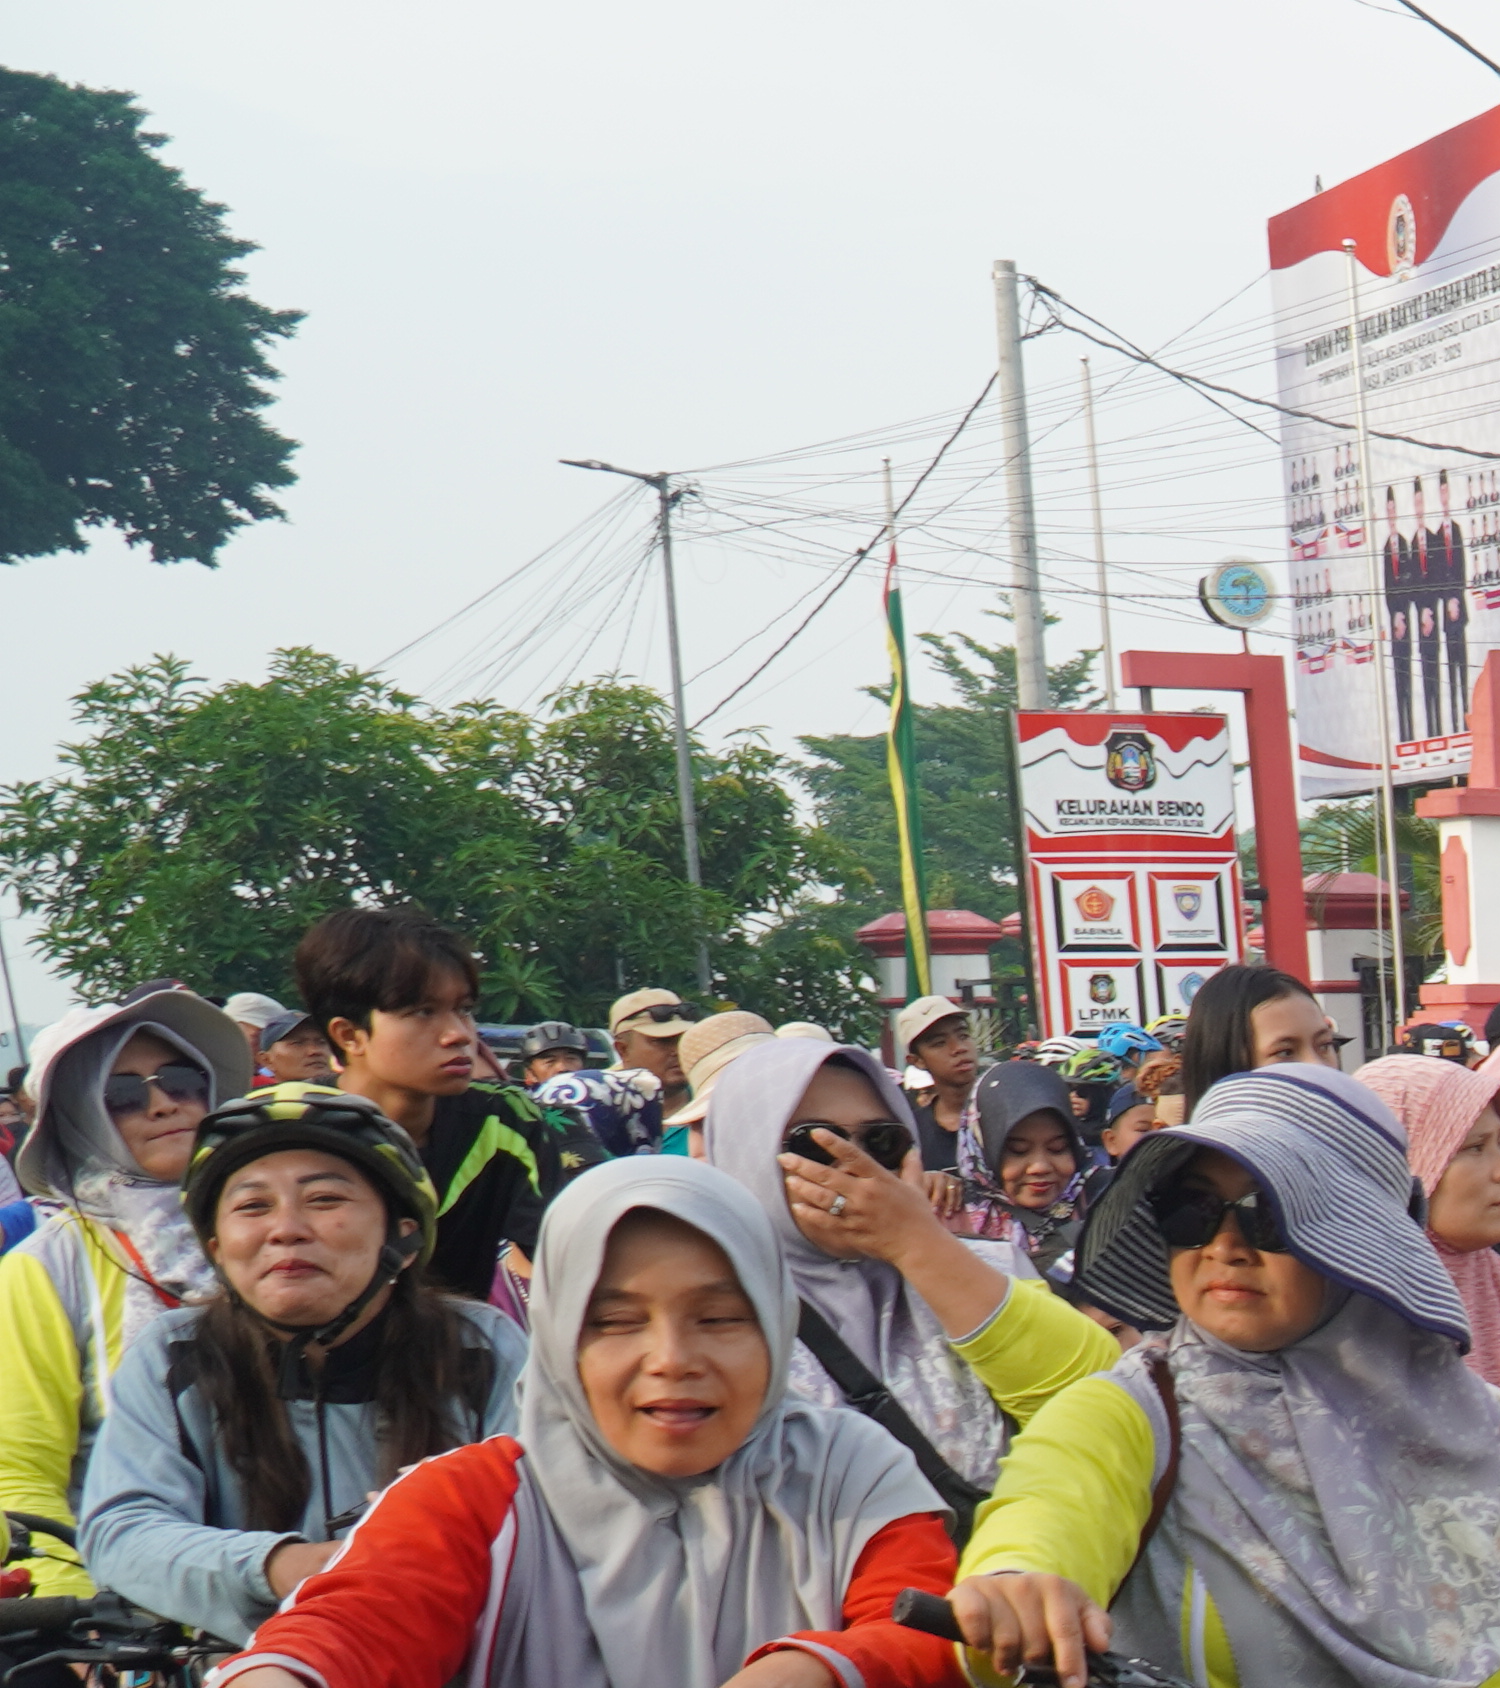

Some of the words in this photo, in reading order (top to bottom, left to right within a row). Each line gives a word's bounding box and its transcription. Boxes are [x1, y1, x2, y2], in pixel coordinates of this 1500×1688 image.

[1055, 799, 1153, 816] KELURAHAN
[1157, 800, 1205, 817] BENDO
[1077, 1007, 1131, 1021] LPMK
